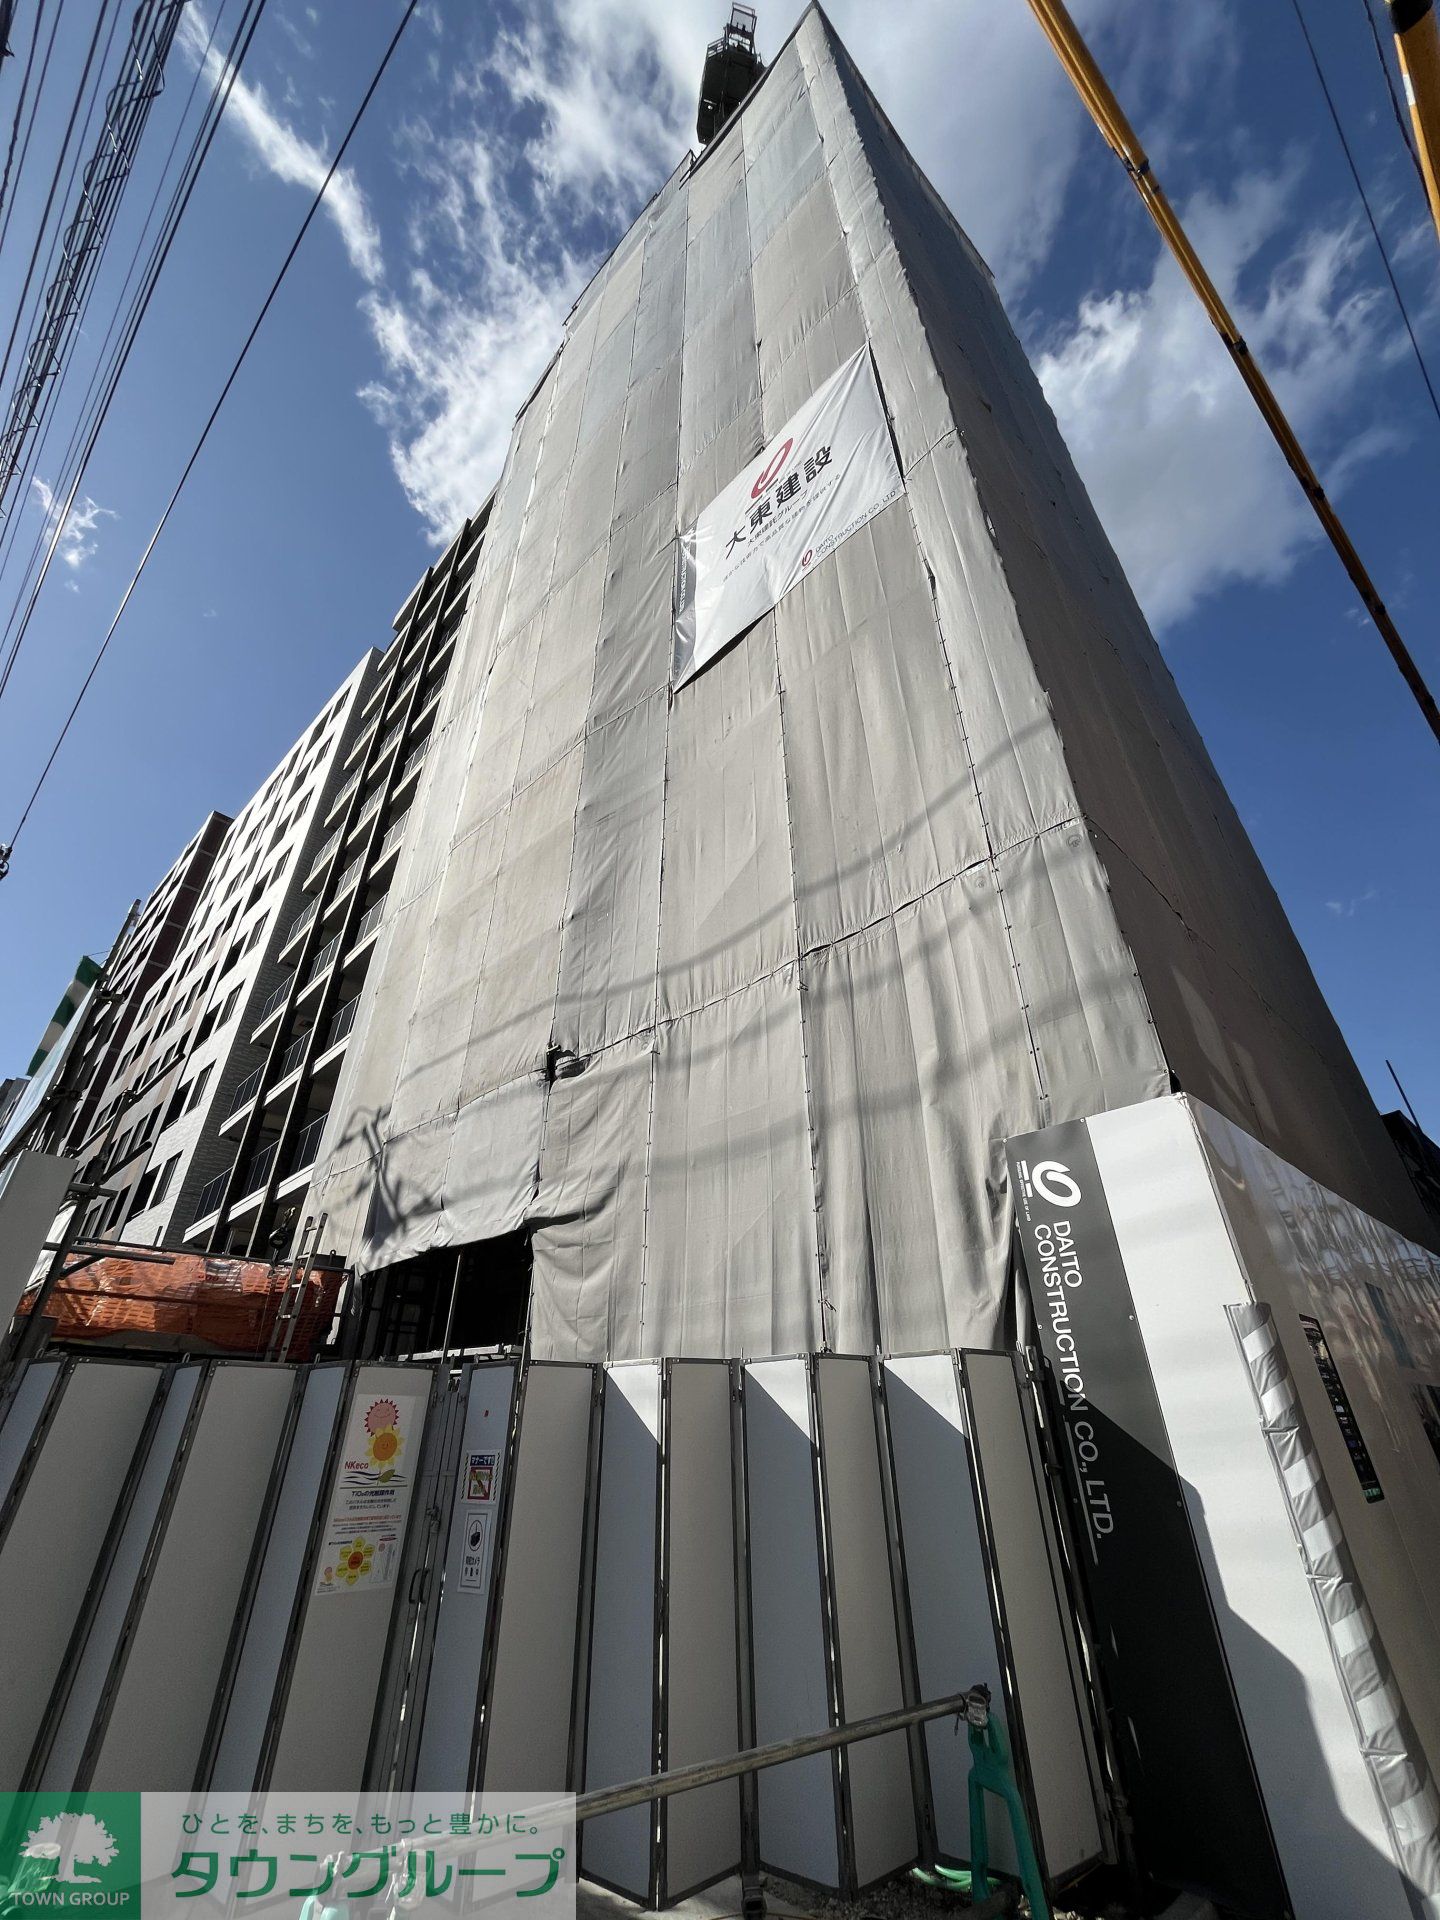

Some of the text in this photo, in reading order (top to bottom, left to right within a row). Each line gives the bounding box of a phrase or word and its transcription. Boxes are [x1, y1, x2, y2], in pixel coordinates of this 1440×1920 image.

[725, 445, 833, 560] 大東建設
[815, 534, 834, 553] DAITO
[817, 512, 867, 558] CONSTRUCTION
[1053, 1220, 1082, 1288] DAITO
[1034, 1224, 1114, 1539] CONSTRUCTION CO., LTD.
[344, 1461, 369, 1469] NKeco
